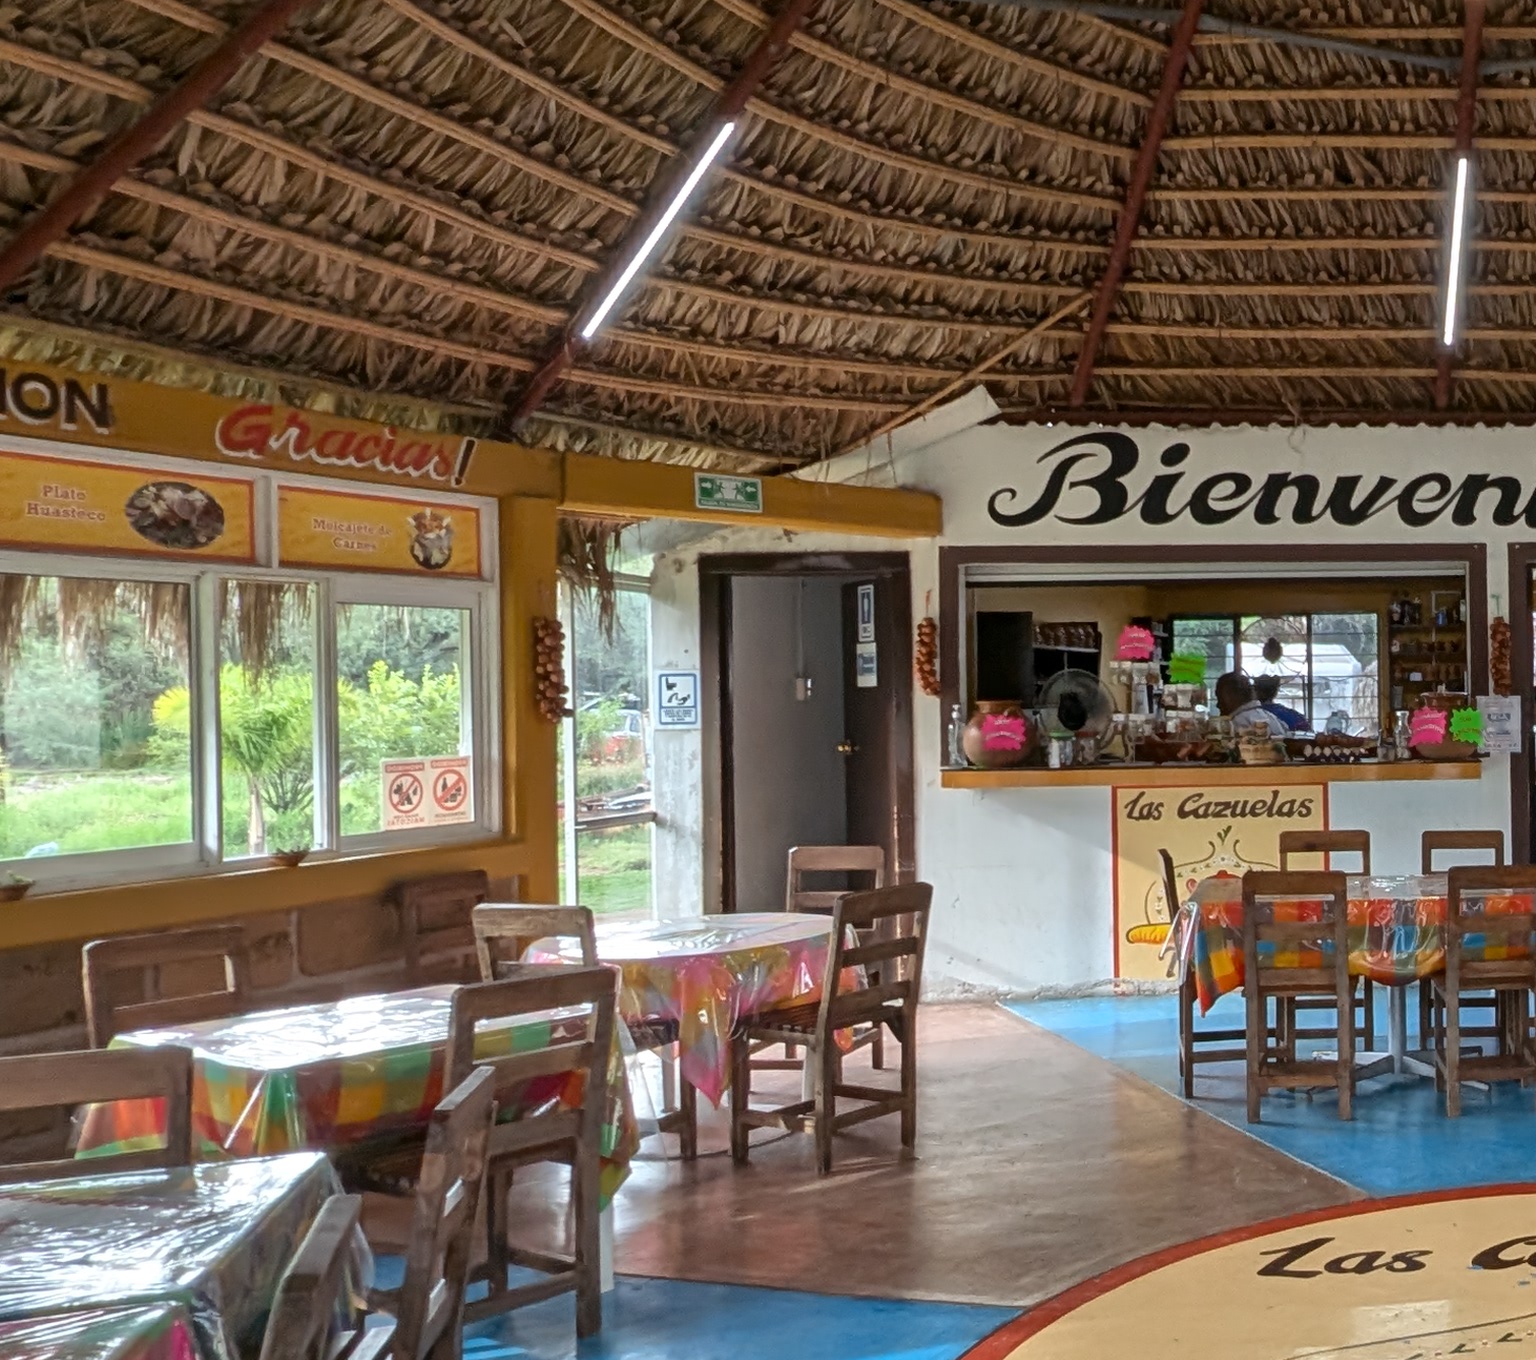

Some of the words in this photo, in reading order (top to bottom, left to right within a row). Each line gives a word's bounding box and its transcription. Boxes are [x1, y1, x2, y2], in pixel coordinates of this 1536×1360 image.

[215, 404, 478, 487] Gracias!
[42, 486, 86, 501] Plato
[26, 503, 106, 521] Huasteco
[1124, 791, 1164, 821] Las
[1177, 790, 1314, 820] Cazuelas
[1256, 1237, 1434, 1279] Las
